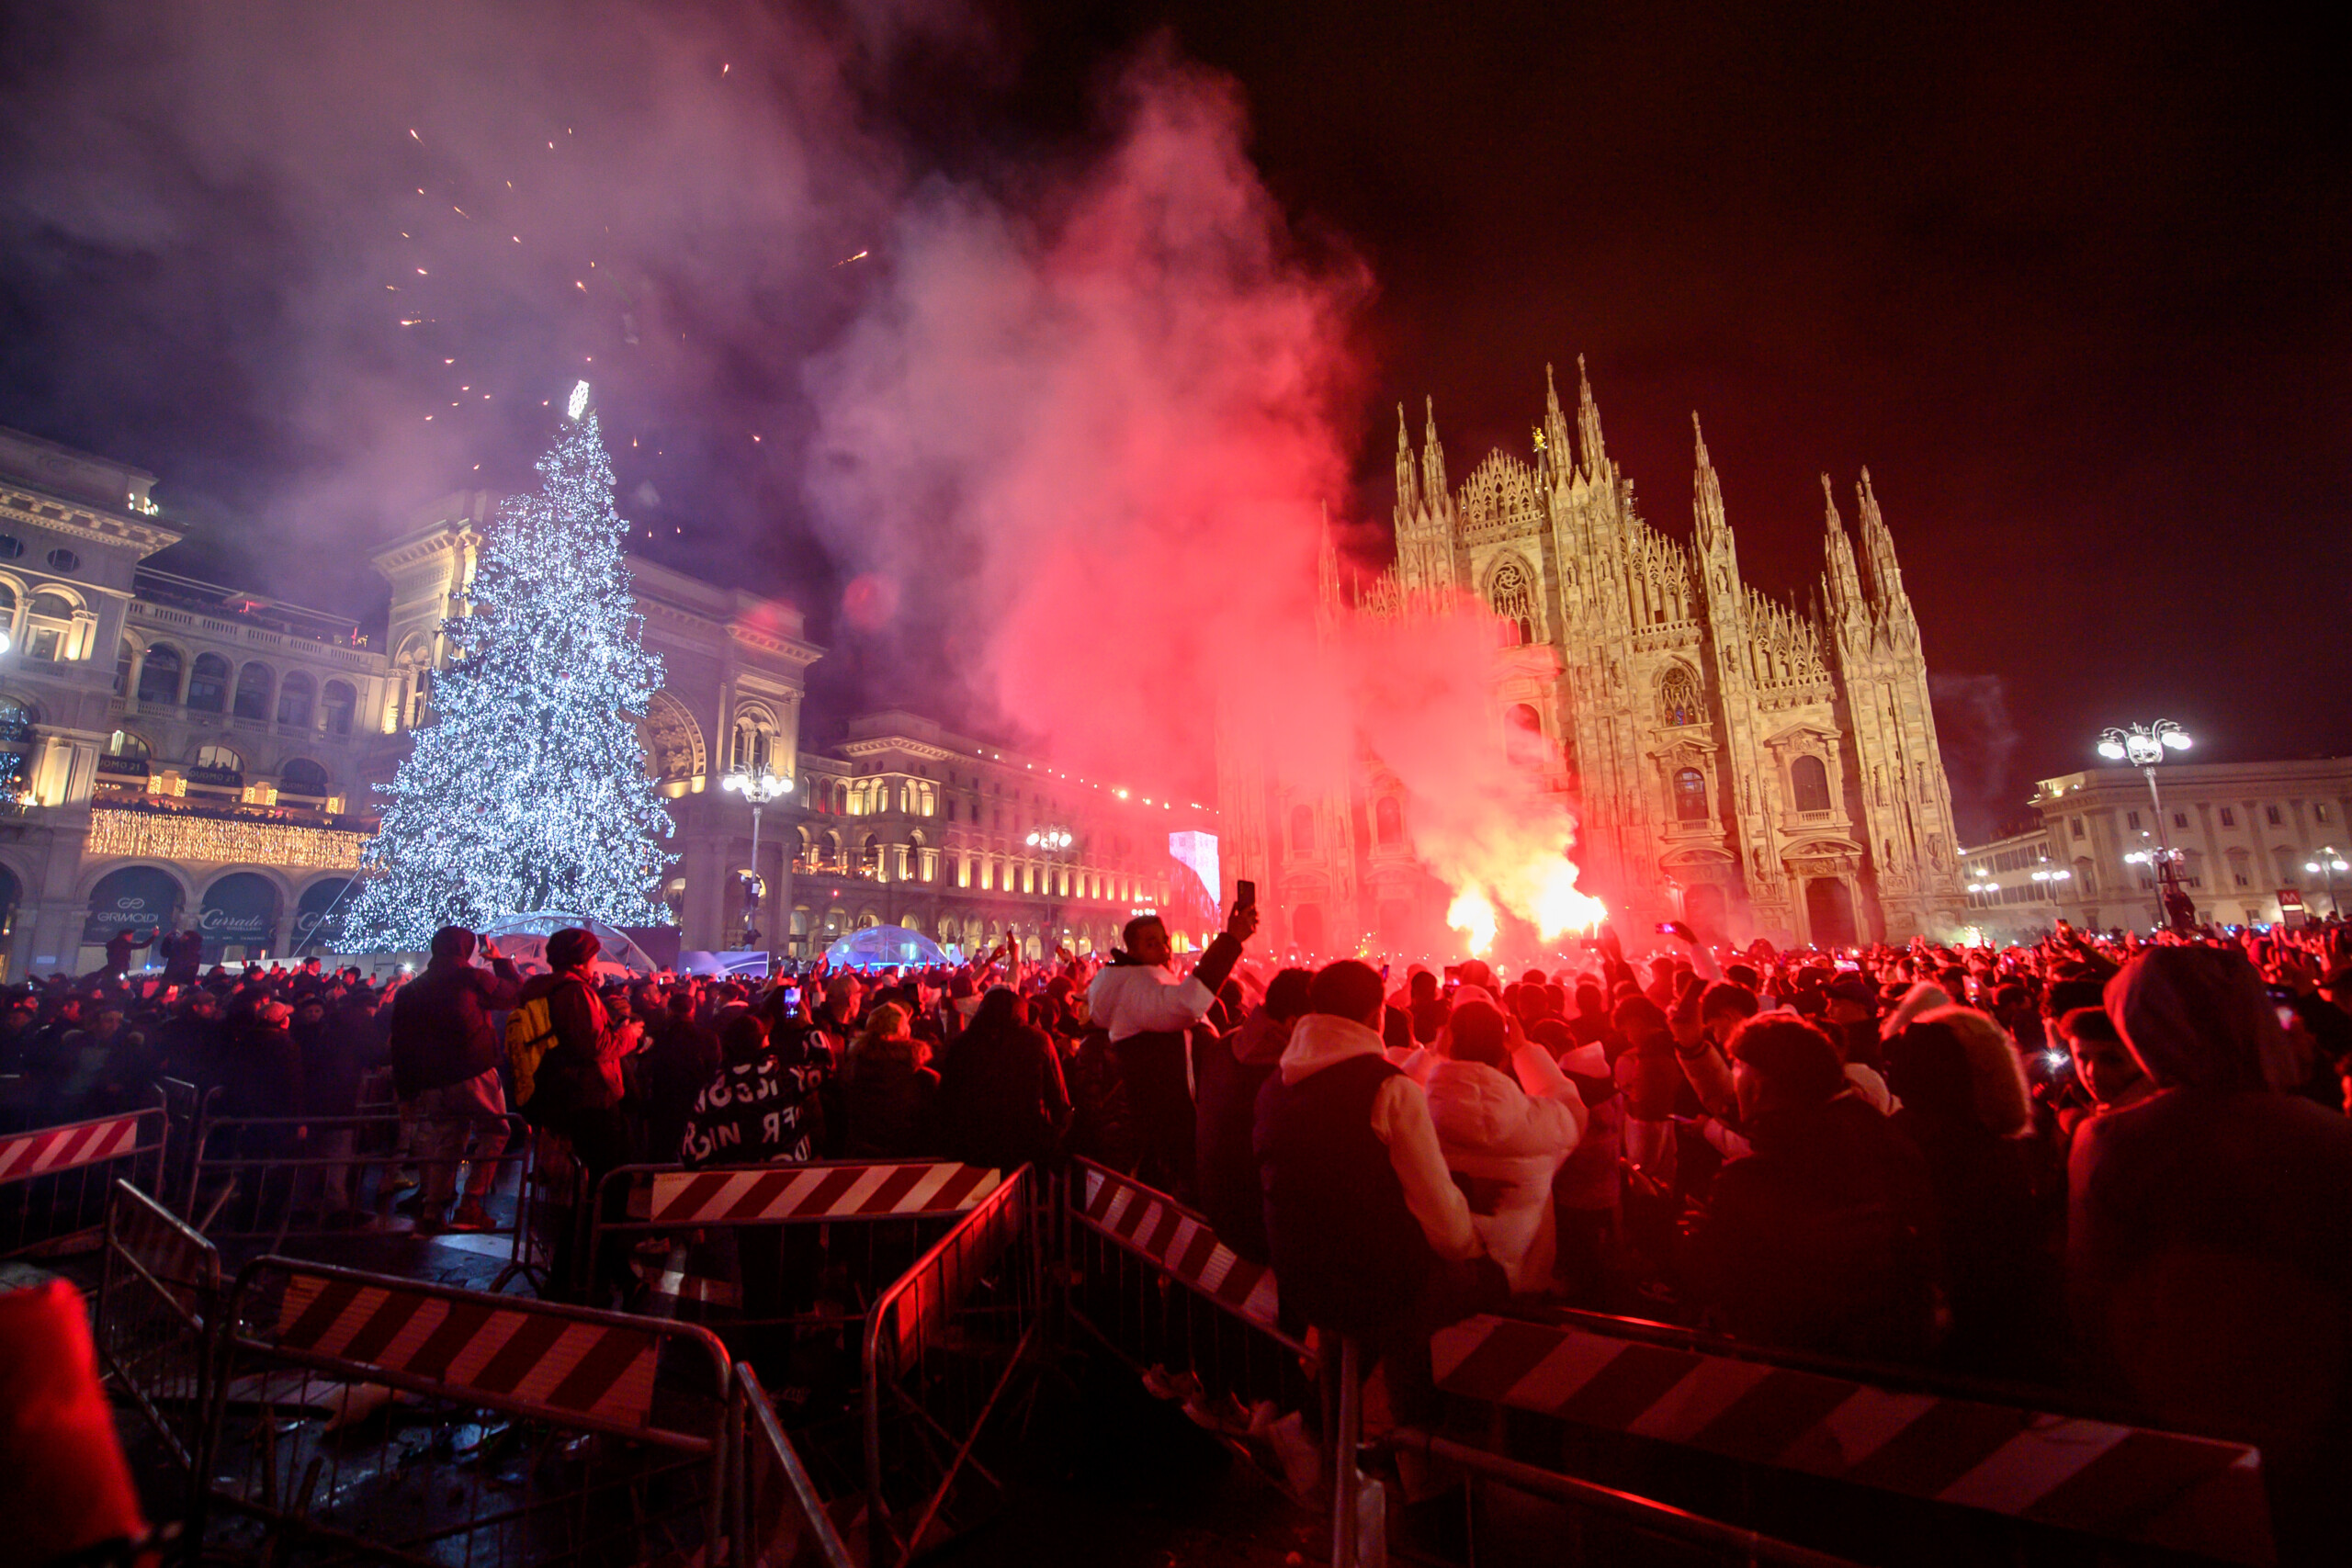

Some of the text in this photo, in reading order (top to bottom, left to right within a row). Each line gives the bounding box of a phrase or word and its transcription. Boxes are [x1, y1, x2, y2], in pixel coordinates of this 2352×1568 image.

[190, 770, 224, 781] DUOMO
[97, 912, 159, 923] GRIMOLDI
[199, 908, 264, 930] Currado
